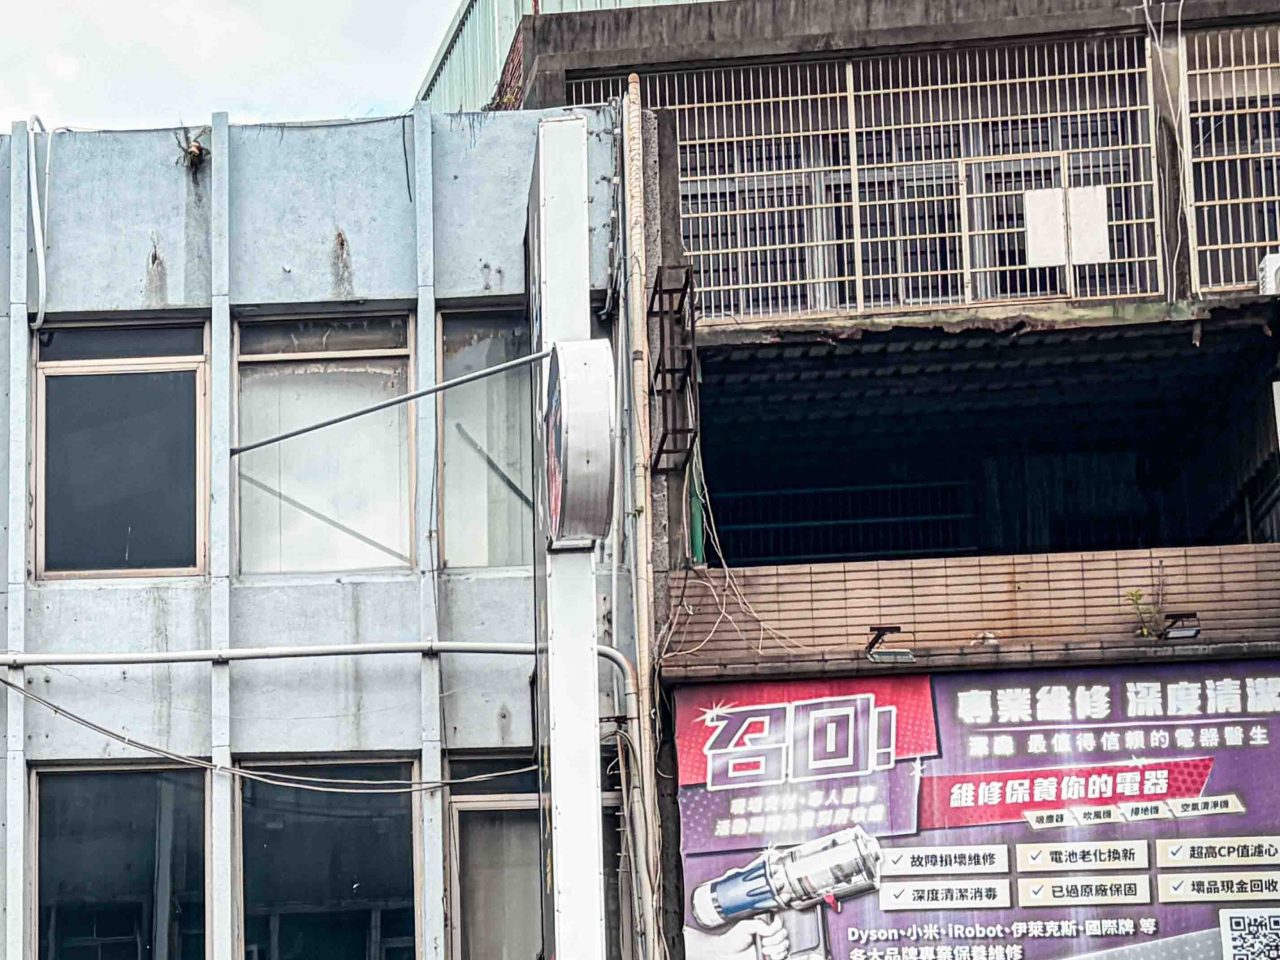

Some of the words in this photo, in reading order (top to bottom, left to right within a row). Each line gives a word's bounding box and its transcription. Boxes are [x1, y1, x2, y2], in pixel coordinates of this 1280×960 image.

[949, 769, 1169, 808] 維修保養你的電器
[910, 852, 996, 868] 故障損壞維修
[1049, 848, 1136, 864] 電池老化換新
[1189, 843, 1279, 860] 超高CP值濾心
[912, 887, 998, 902] 深度清潔消毒
[1051, 882, 1138, 899] 已過原廠保固
[1191, 878, 1279, 894] 壞品現金回收
[1140, 917, 1157, 935] 等
